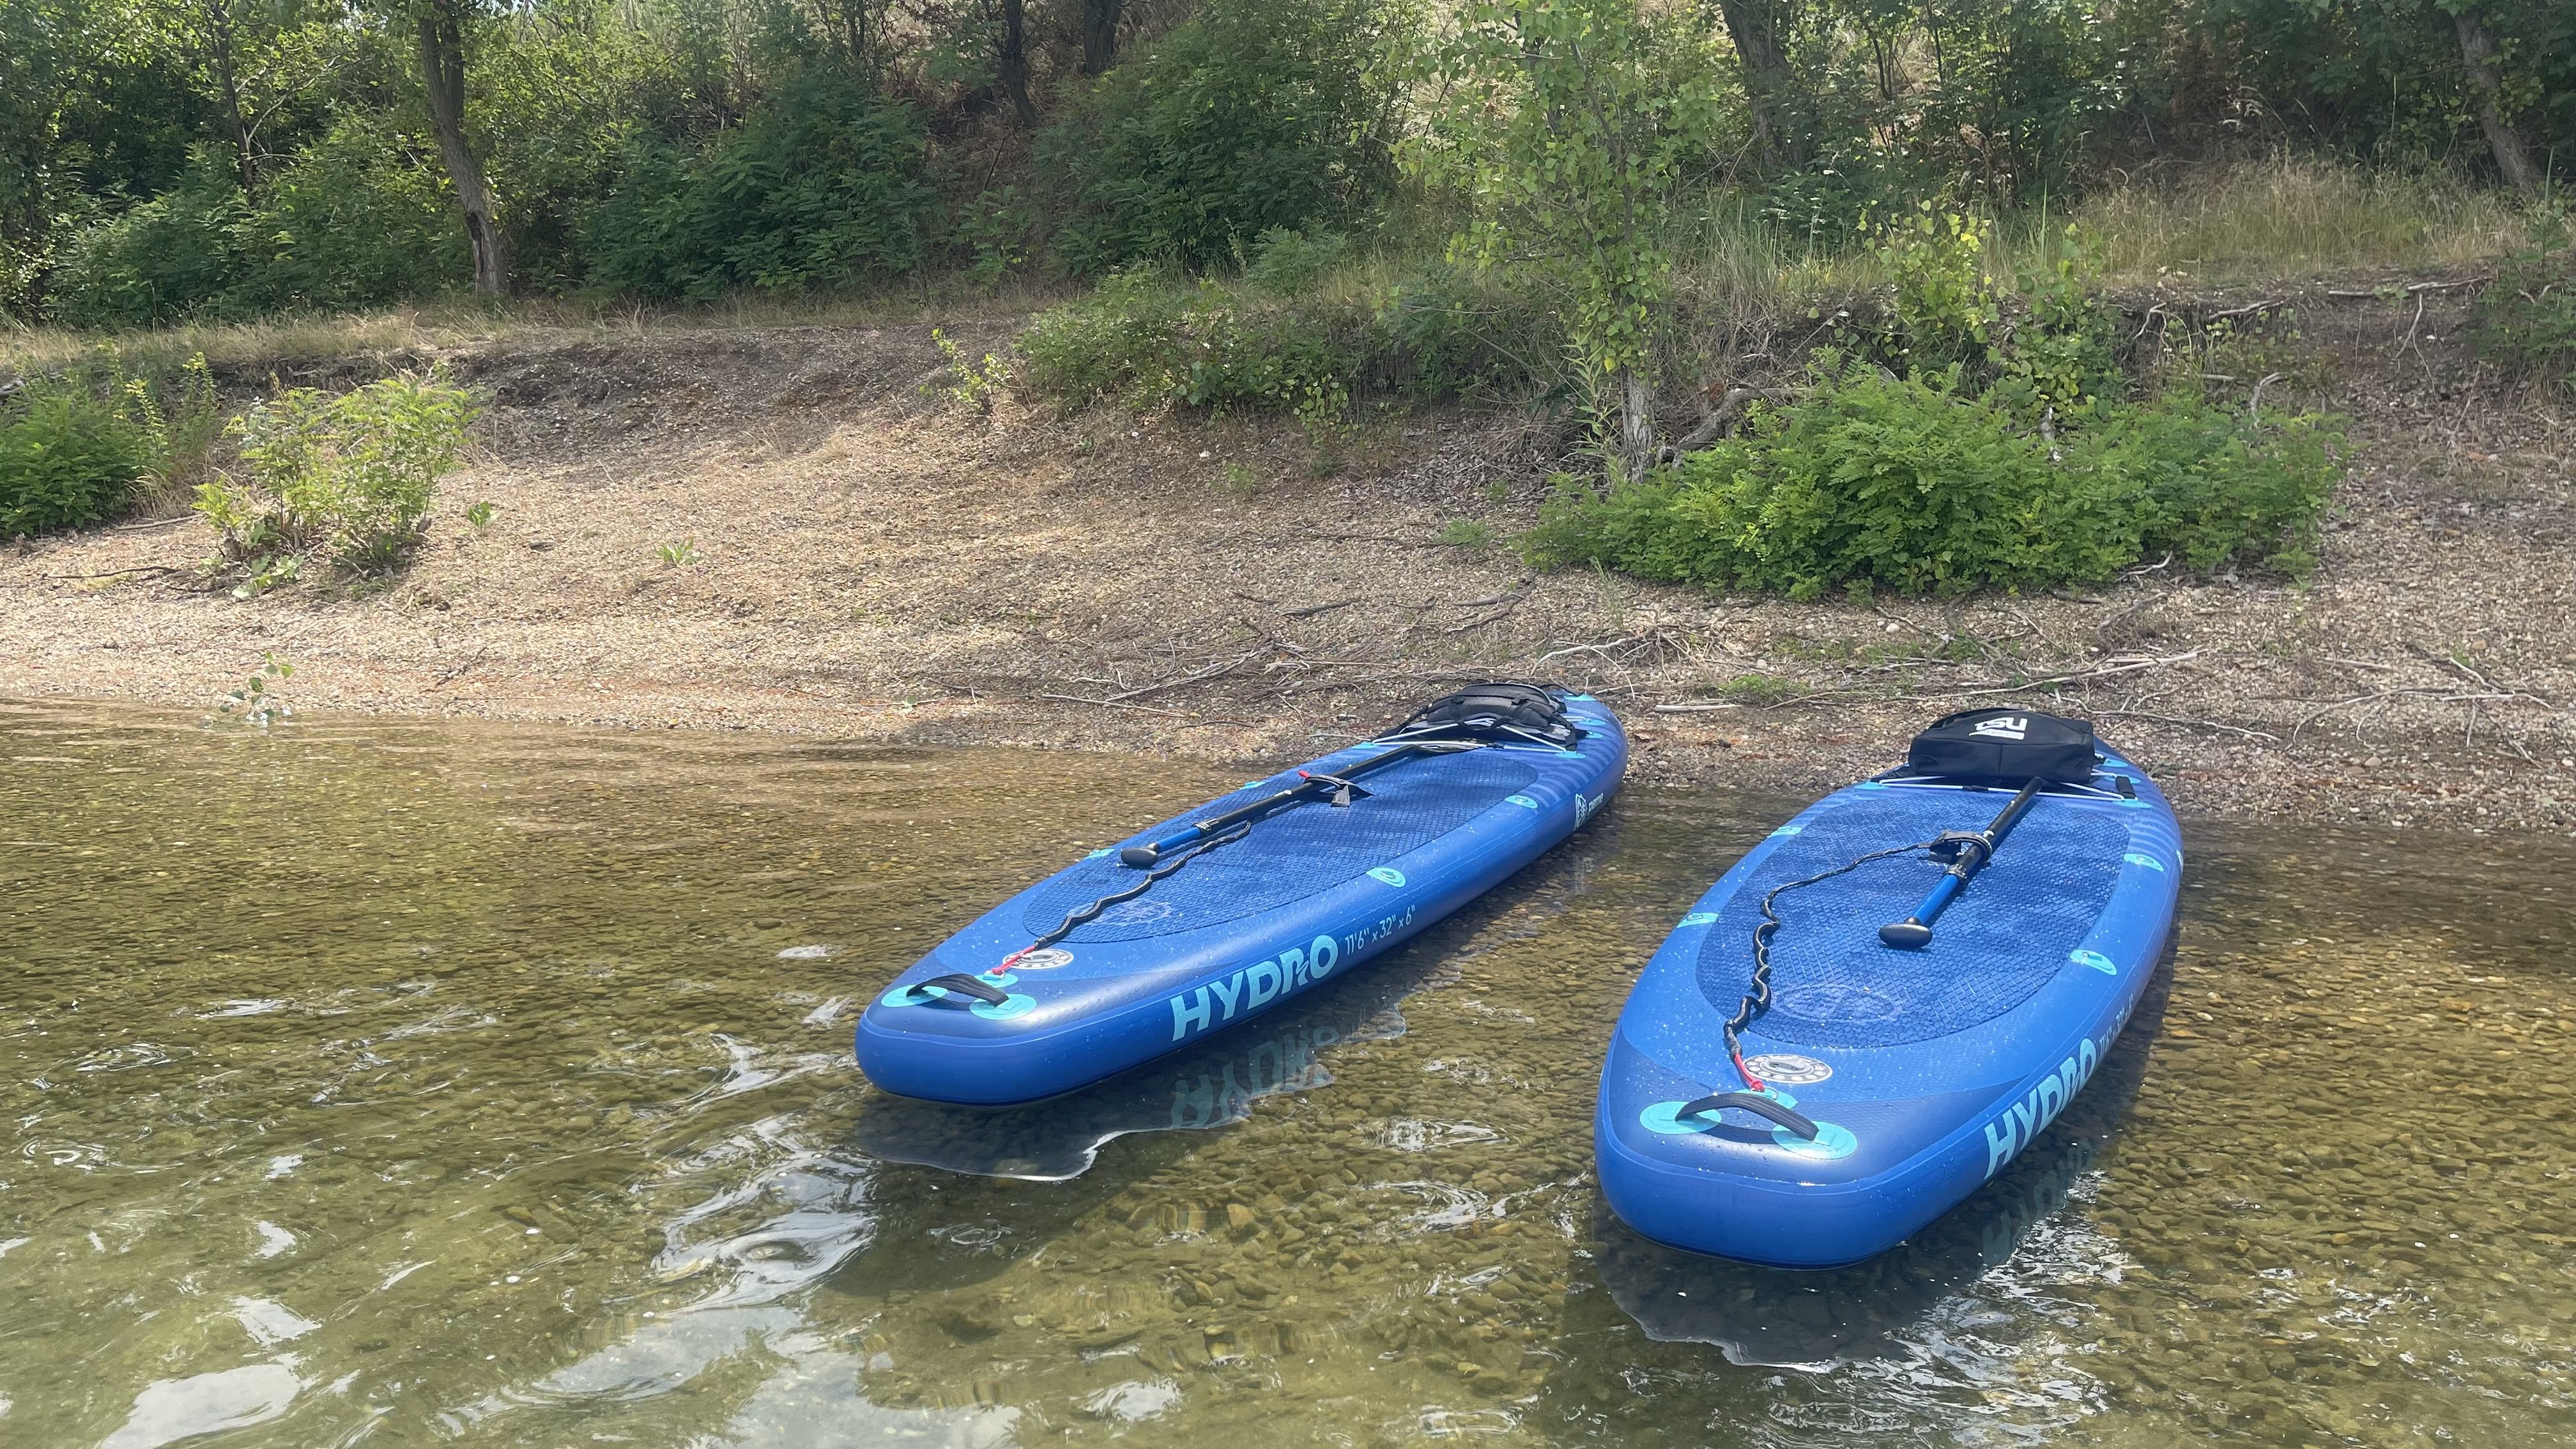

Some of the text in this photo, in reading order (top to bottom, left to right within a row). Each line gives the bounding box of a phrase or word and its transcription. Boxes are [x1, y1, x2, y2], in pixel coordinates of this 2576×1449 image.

[1170, 904, 1416, 1042] HYDRO 11'6" x 32" x 6"
[1984, 1038, 2097, 1181] HYDRO
